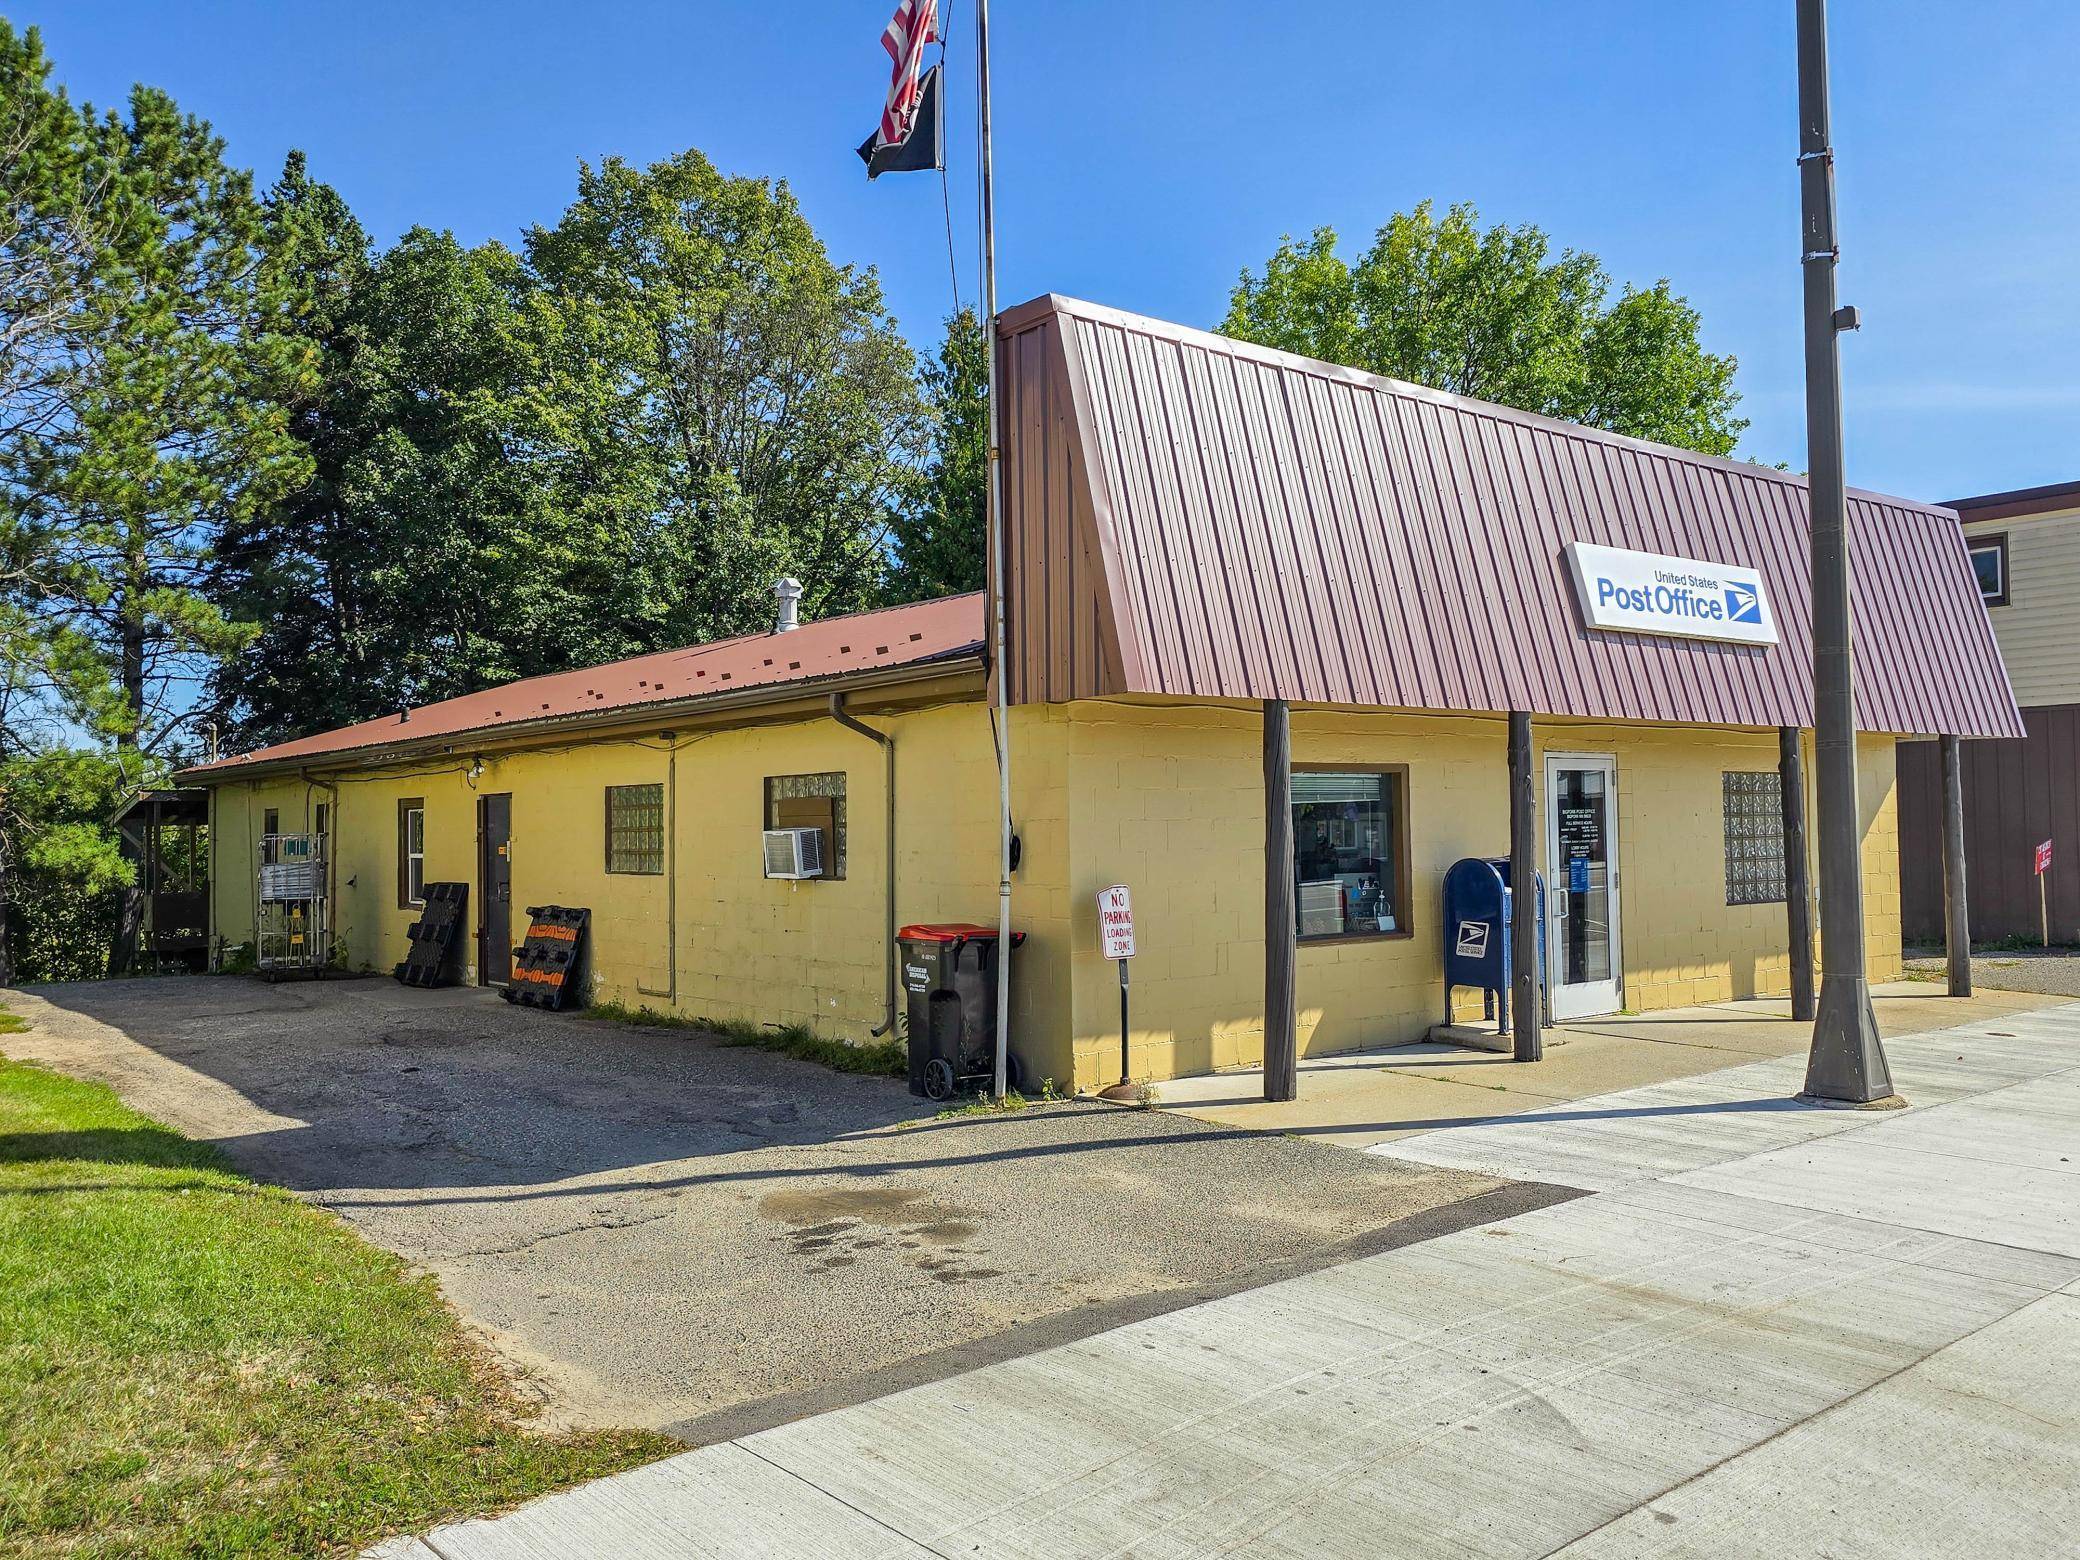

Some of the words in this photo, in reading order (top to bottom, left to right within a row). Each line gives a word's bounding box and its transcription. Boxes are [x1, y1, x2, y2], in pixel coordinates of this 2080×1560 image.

[1655, 570, 1687, 586] United
[1688, 575, 1719, 590] States
[1111, 893, 1125, 907] NO
[1114, 941, 1130, 951] ZONE
